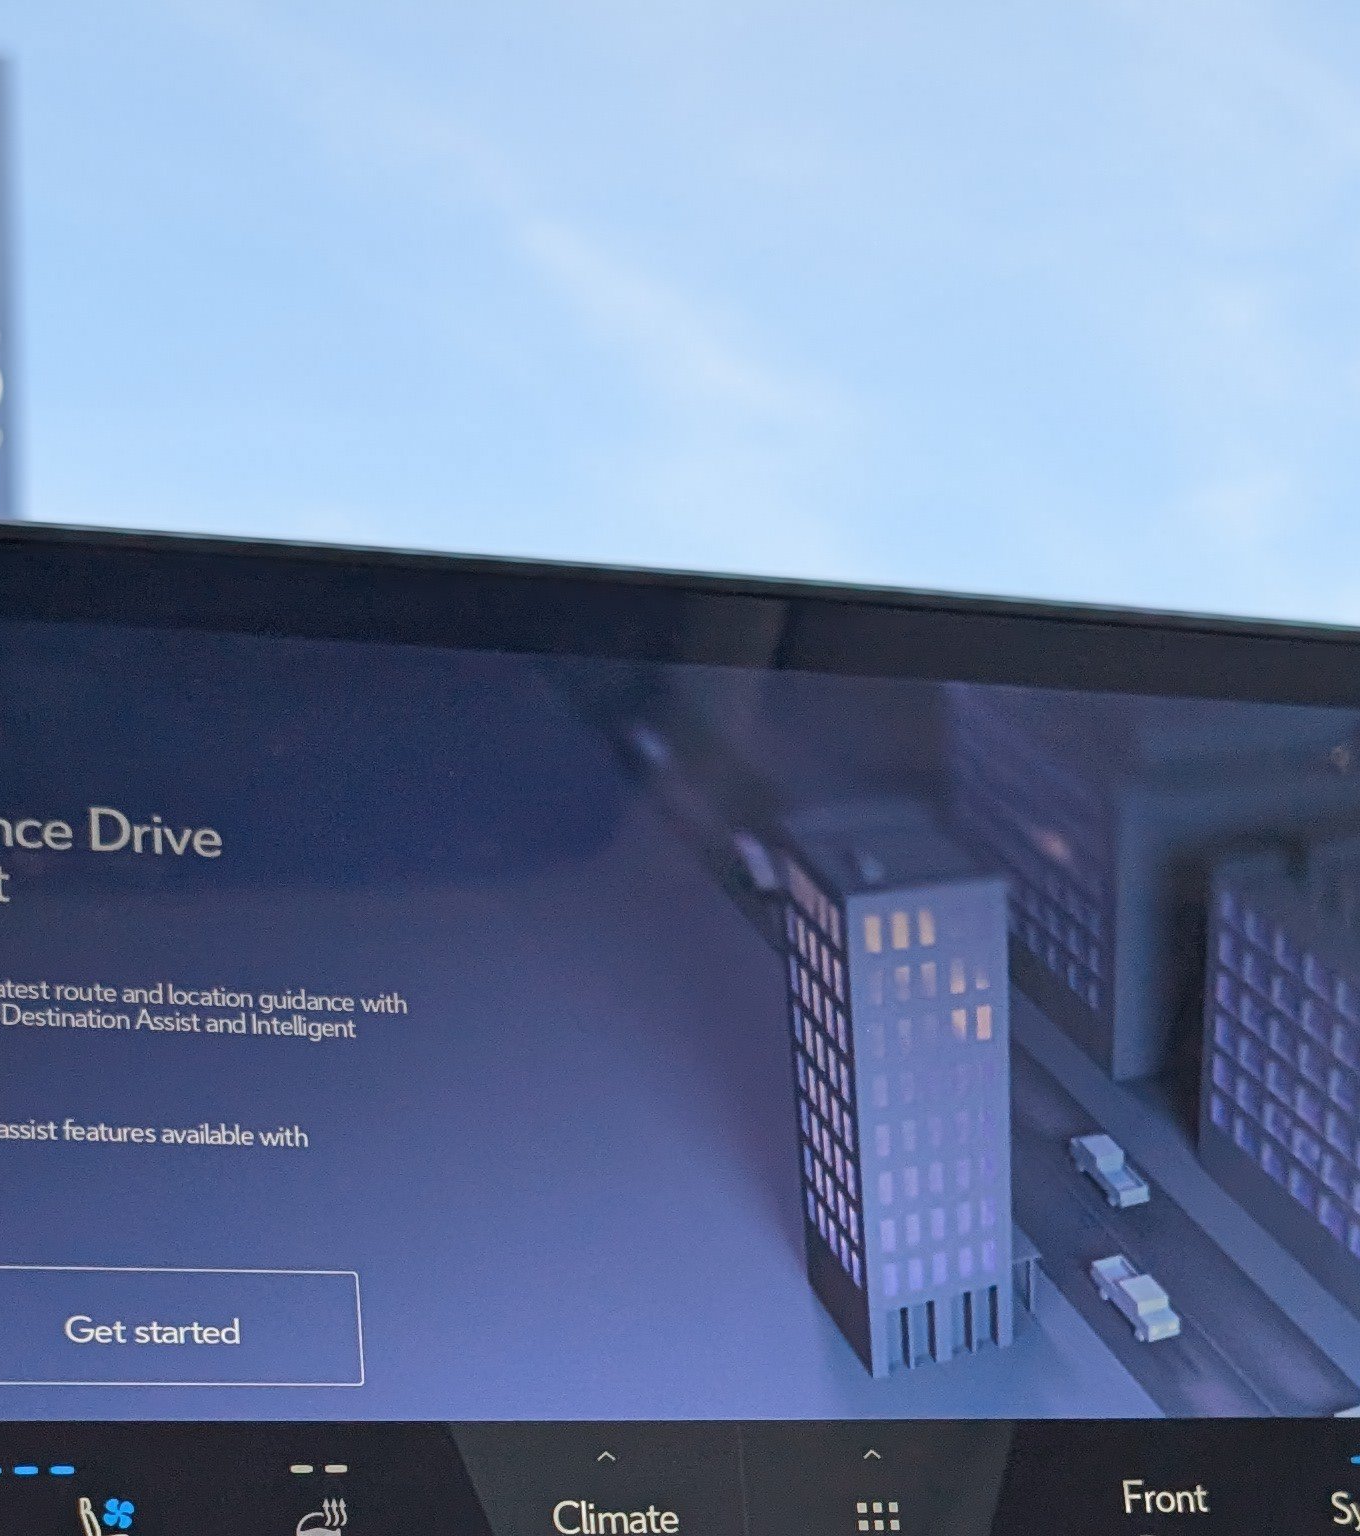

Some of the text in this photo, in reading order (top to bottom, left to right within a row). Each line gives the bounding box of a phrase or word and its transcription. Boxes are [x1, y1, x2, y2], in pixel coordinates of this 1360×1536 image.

[89, 807, 223, 858] Drive
[56, 984, 117, 1003] route
[123, 985, 163, 1005] and
[168, 985, 253, 1008] location
[260, 990, 355, 1014] guidance
[361, 994, 408, 1014] with
[1, 1004, 131, 1030] Destination
[136, 1009, 201, 1033] Assist
[206, 1013, 246, 1034] and
[252, 1014, 357, 1042] Intelligent
[63, 1119, 156, 1143] features
[161, 1123, 254, 1146] available
[259, 1127, 309, 1148] with
[65, 1316, 242, 1345] Get started
[1122, 1479, 1210, 1514] Front
[552, 1499, 680, 1535] Climate
